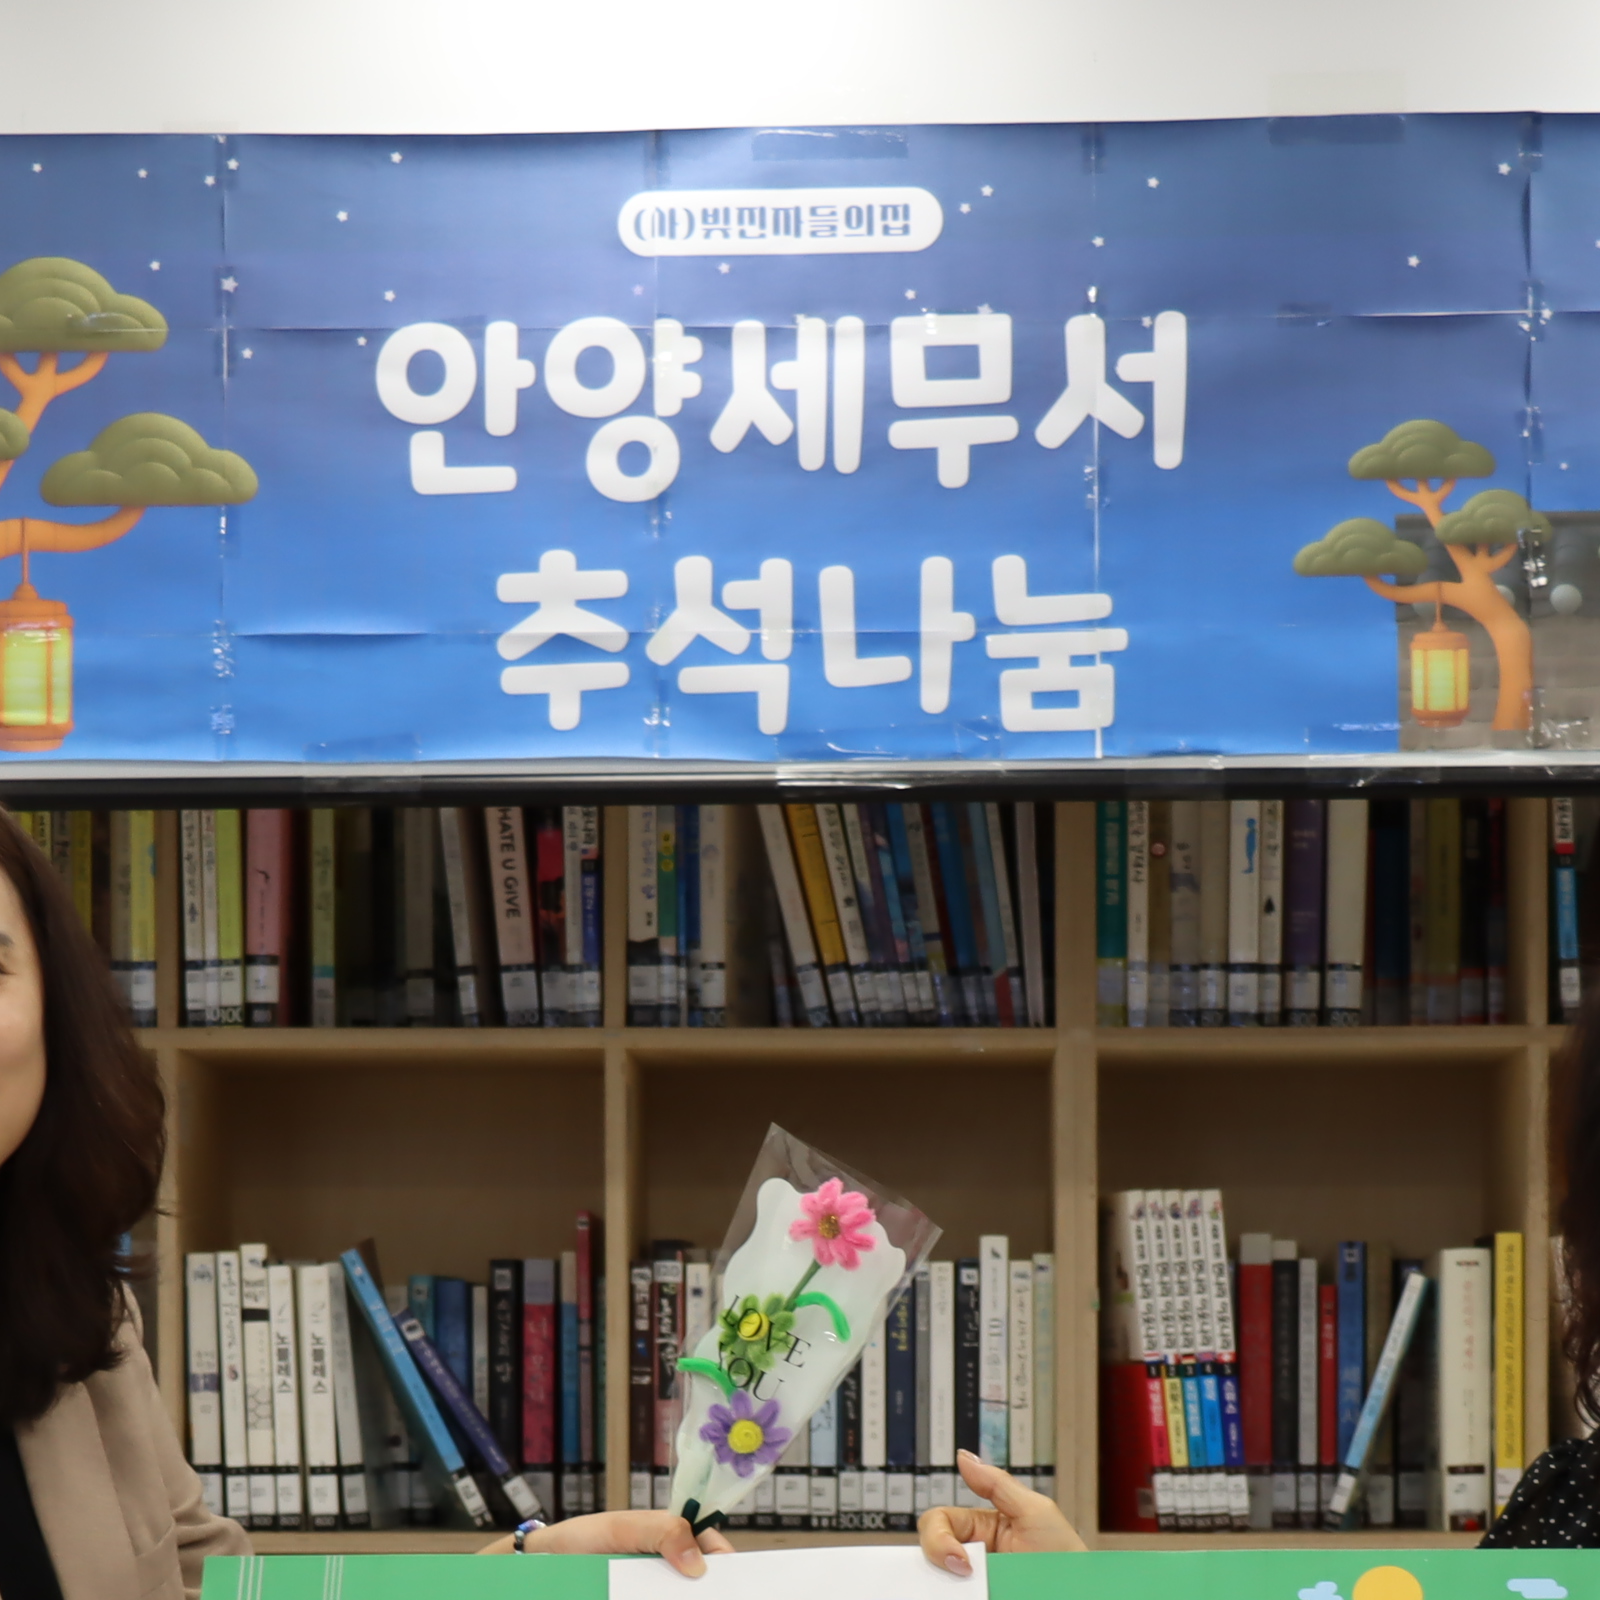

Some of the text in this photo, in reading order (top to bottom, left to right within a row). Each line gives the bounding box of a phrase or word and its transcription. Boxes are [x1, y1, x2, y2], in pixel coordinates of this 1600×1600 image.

[633, 203, 912, 243] (사)빚진자들의집
[375, 310, 1188, 503] 안양세무서
[495, 549, 1129, 736] 추석나눔
[498, 807, 521, 920] HATE U GIVE
